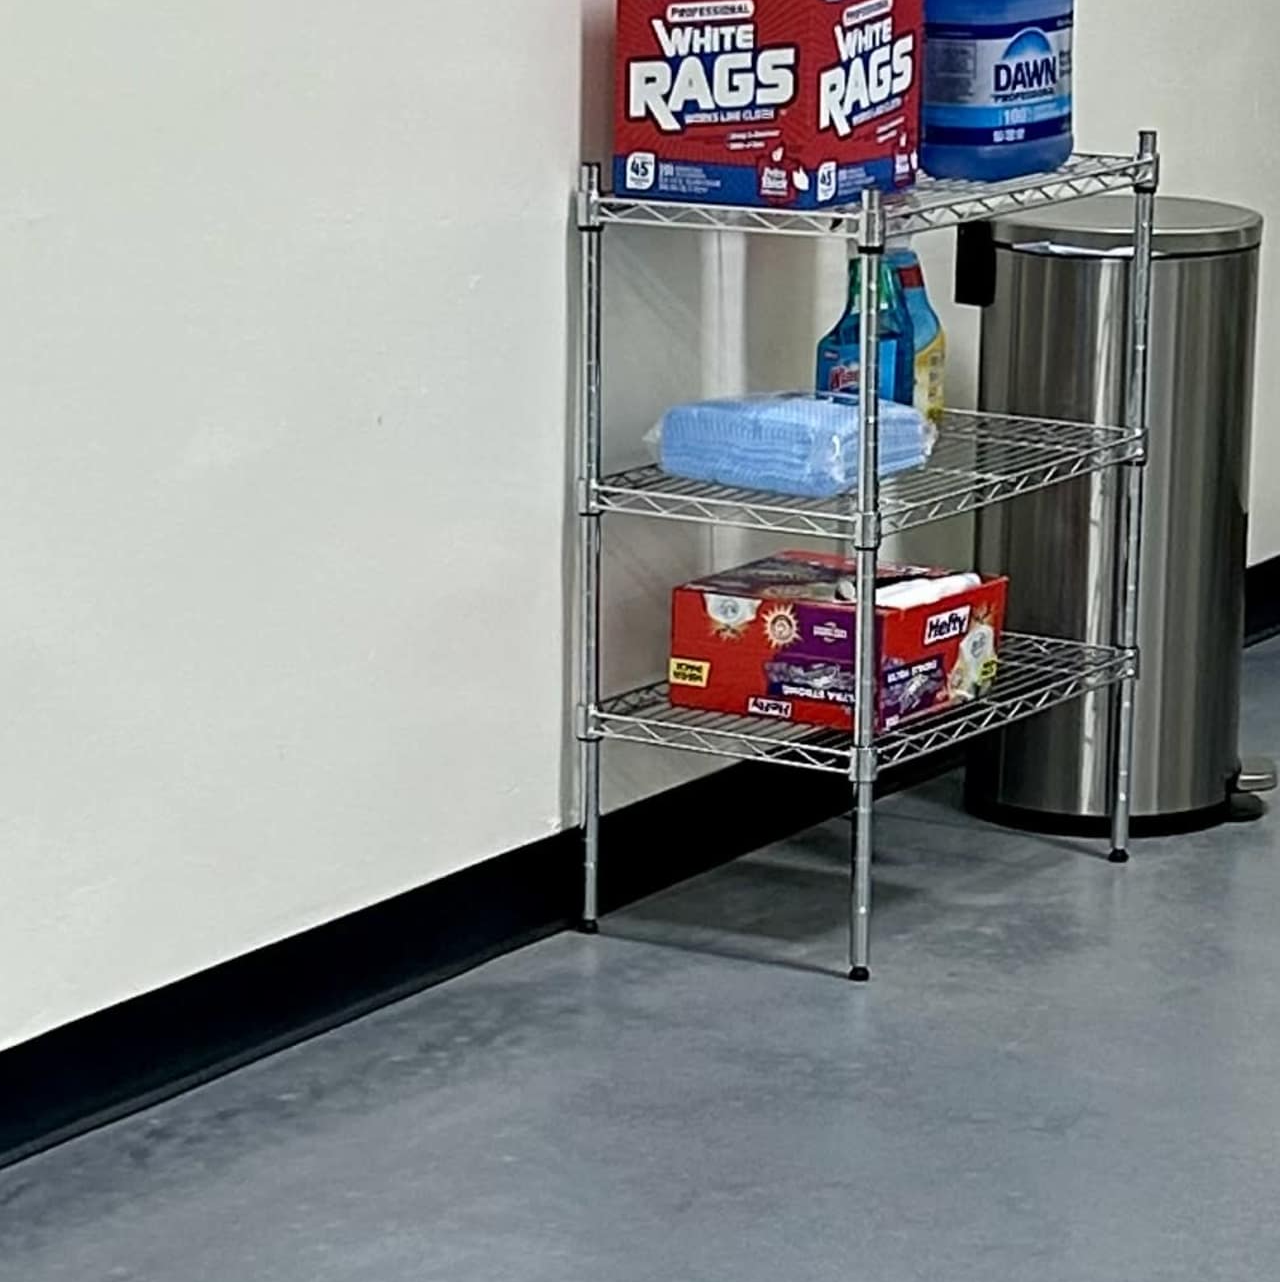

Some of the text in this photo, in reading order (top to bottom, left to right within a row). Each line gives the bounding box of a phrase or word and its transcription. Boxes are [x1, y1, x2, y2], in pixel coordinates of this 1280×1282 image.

[670, 2, 751, 18] PROFESSIONAL
[651, 18, 755, 58] WHITE
[833, 16, 892, 62] WHITE
[628, 47, 796, 131] RAGS
[819, 33, 914, 138] RAGS
[993, 56, 1058, 92] DAWN
[927, 612, 968, 641] Hefty
[751, 697, 791, 718] Hefty
[826, 690, 857, 703] LTRA
